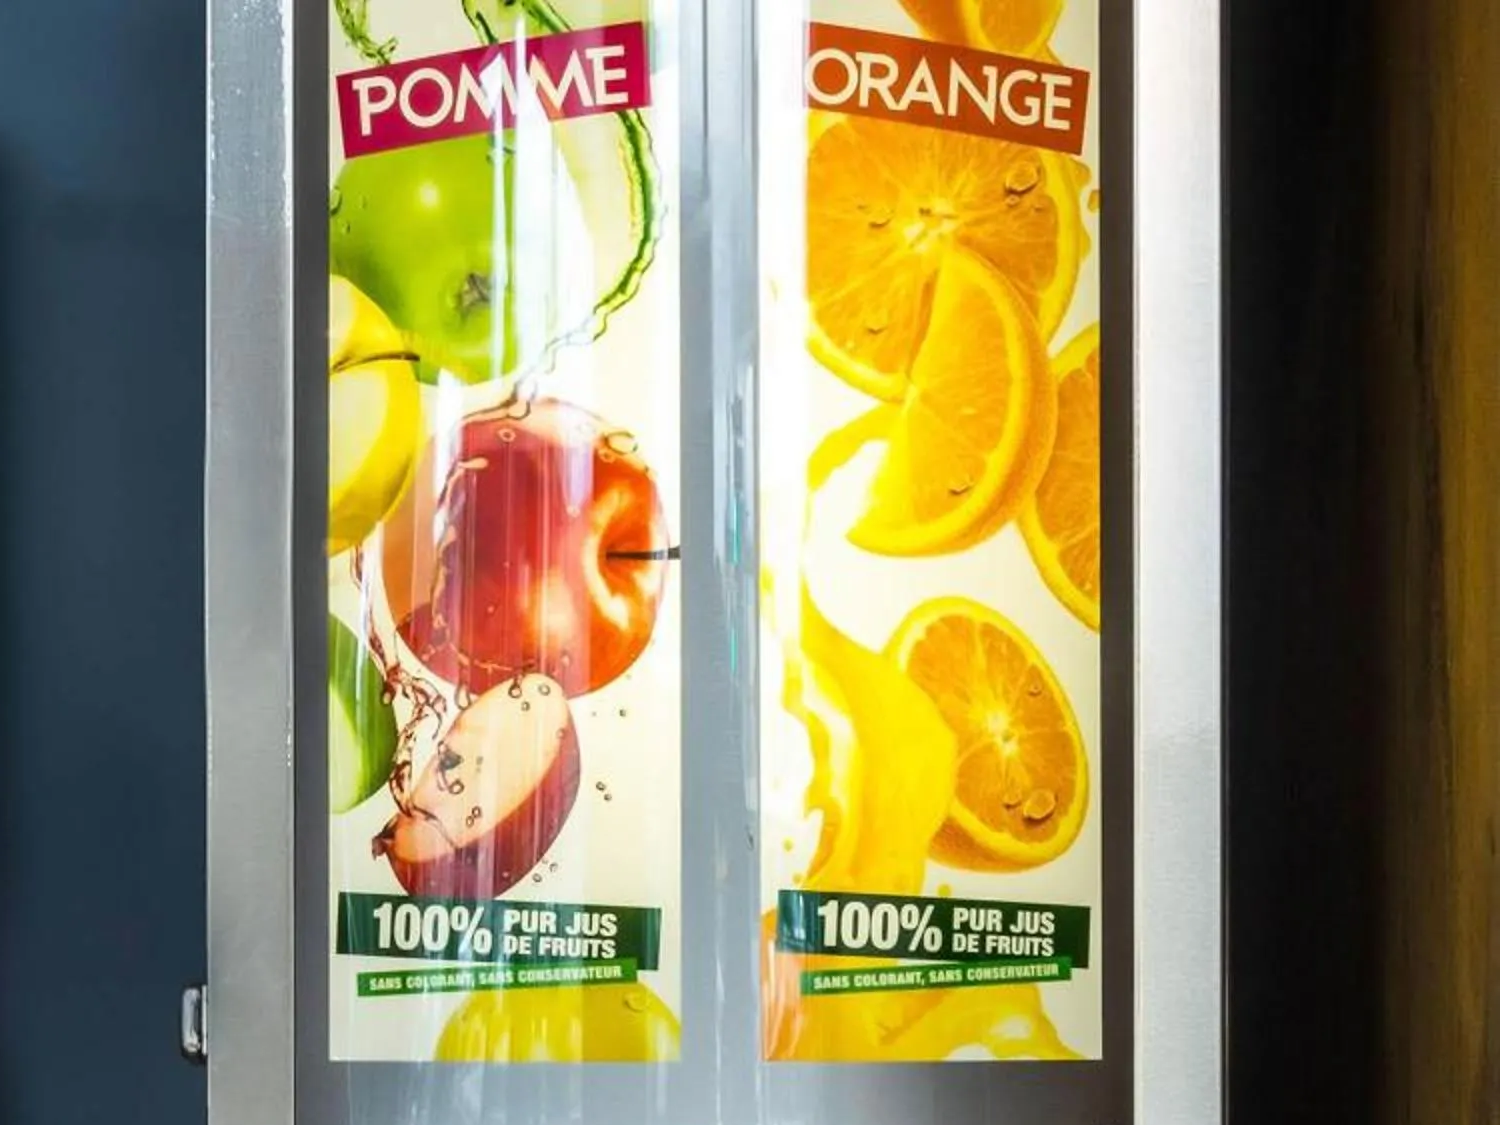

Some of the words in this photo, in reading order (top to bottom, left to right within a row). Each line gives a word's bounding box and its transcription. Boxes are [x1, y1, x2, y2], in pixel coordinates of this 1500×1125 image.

[351, 45, 629, 137] POMME
[804, 47, 1073, 131] ORANGE
[373, 902, 493, 955] 100%
[503, 909, 557, 933] PUR
[565, 911, 617, 937] JUS
[817, 899, 943, 953] 100%
[952, 906, 1002, 932] PUR
[1010, 909, 1055, 935] JUS
[503, 935, 534, 956] DE
[539, 937, 616, 959] FRUITS
[952, 933, 979, 954] DE
[985, 935, 1054, 957] FRUITS
[369, 976, 402, 991] SANS
[479, 971, 514, 985] SANS
[517, 965, 623, 983] CONSERVATEUR
[813, 975, 849, 990] SANS
[929, 968, 963, 983] SANS
[966, 963, 1060, 981] CONSERVATEUR
